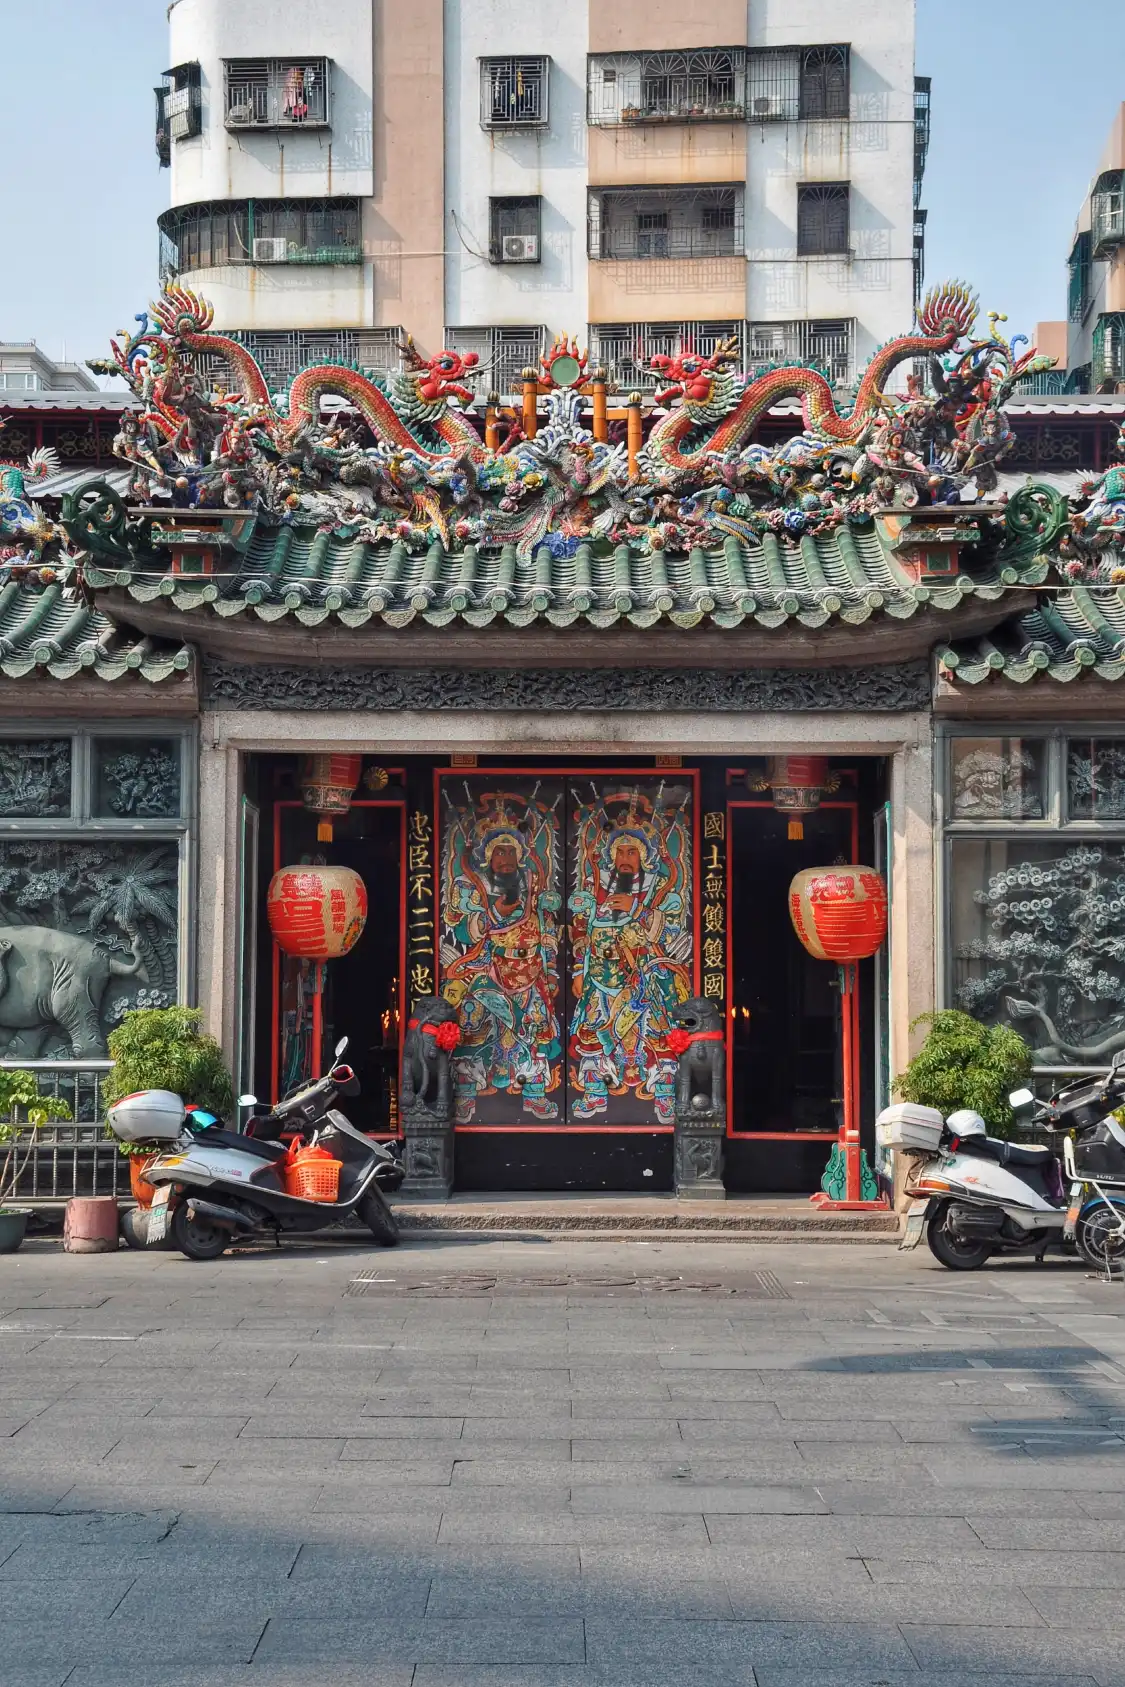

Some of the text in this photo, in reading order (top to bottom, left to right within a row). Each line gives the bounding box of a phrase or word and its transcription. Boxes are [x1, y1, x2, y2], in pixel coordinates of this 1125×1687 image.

[409, 810, 434, 1014] 忠臣不二二忠
[702, 811, 727, 1017] 國士無雙雙國
